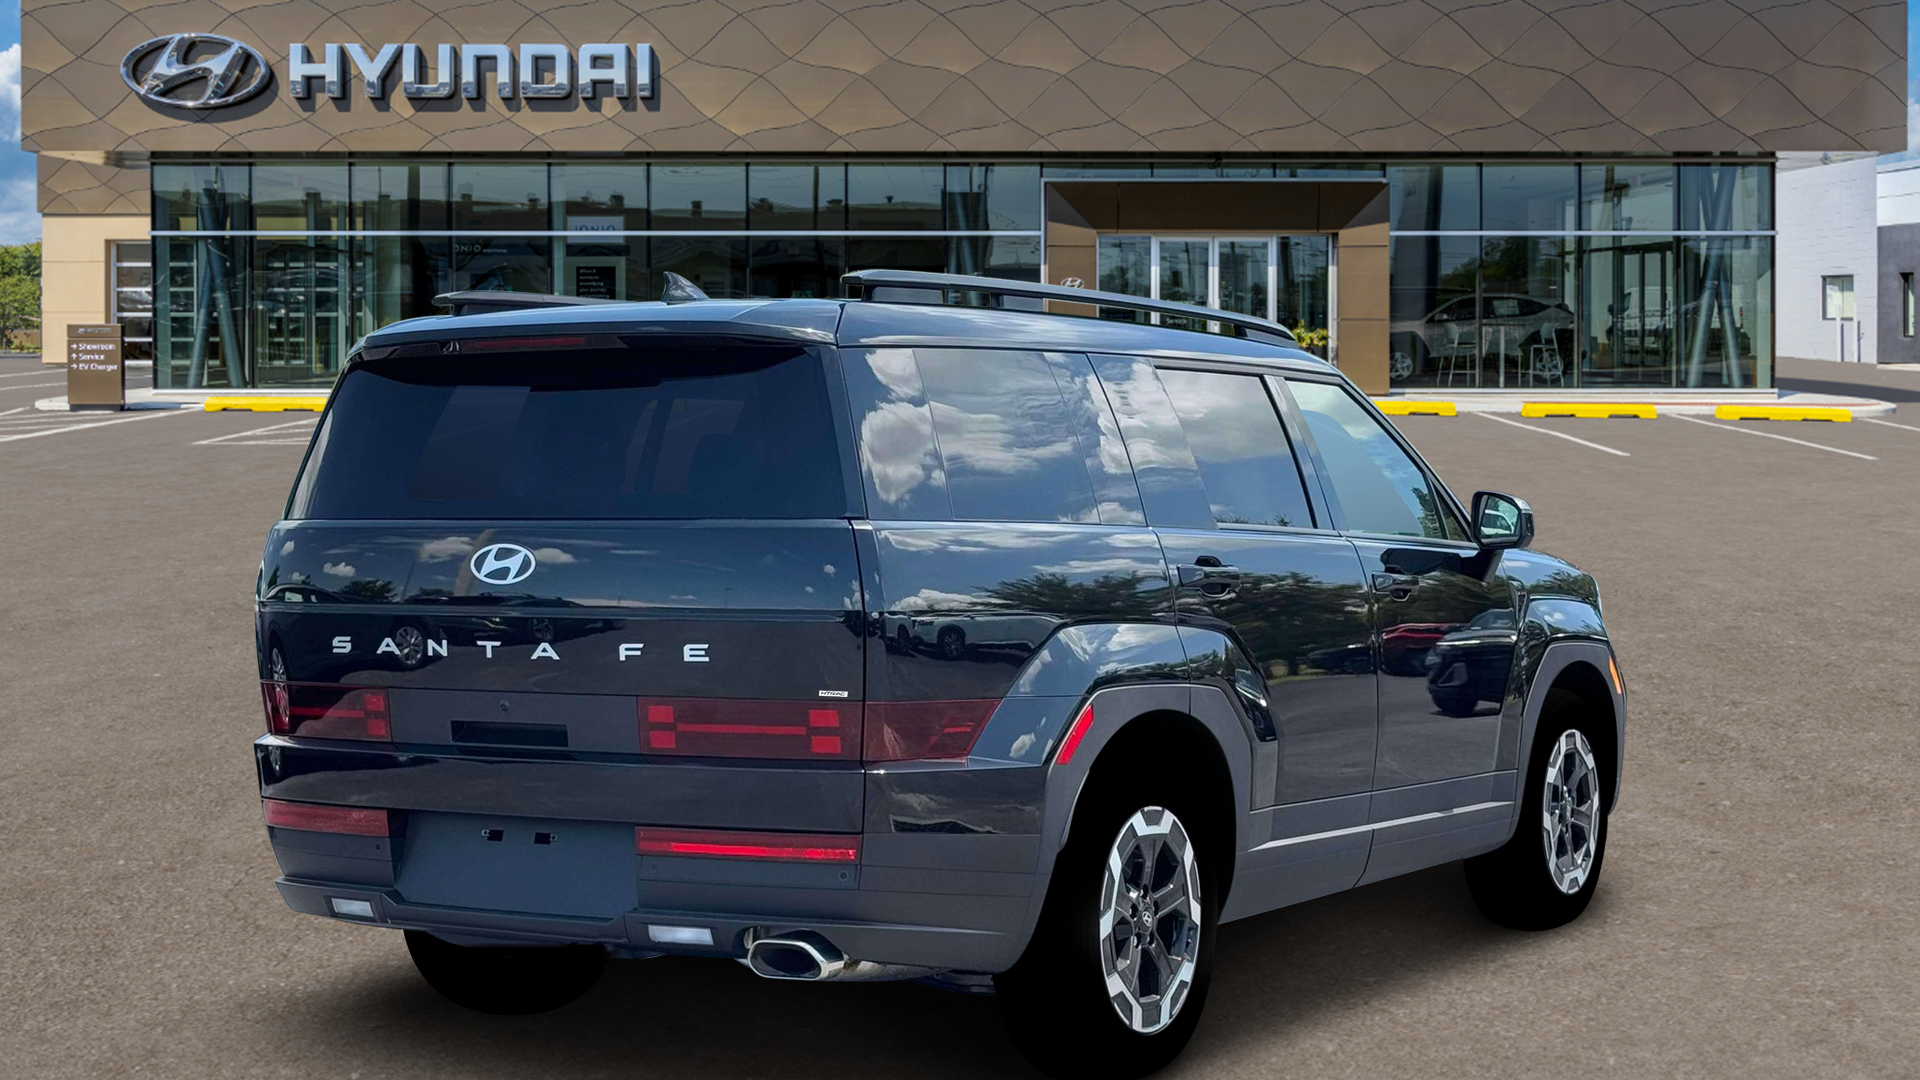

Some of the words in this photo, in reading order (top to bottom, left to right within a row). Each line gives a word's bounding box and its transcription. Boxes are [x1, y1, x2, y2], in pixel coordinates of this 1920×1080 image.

[289, 43, 656, 99] HYUNDAI
[78, 352, 105, 360] Service
[90, 363, 118, 372] Charger
[332, 636, 561, 661] SANTA
[618, 643, 710, 662] FE
